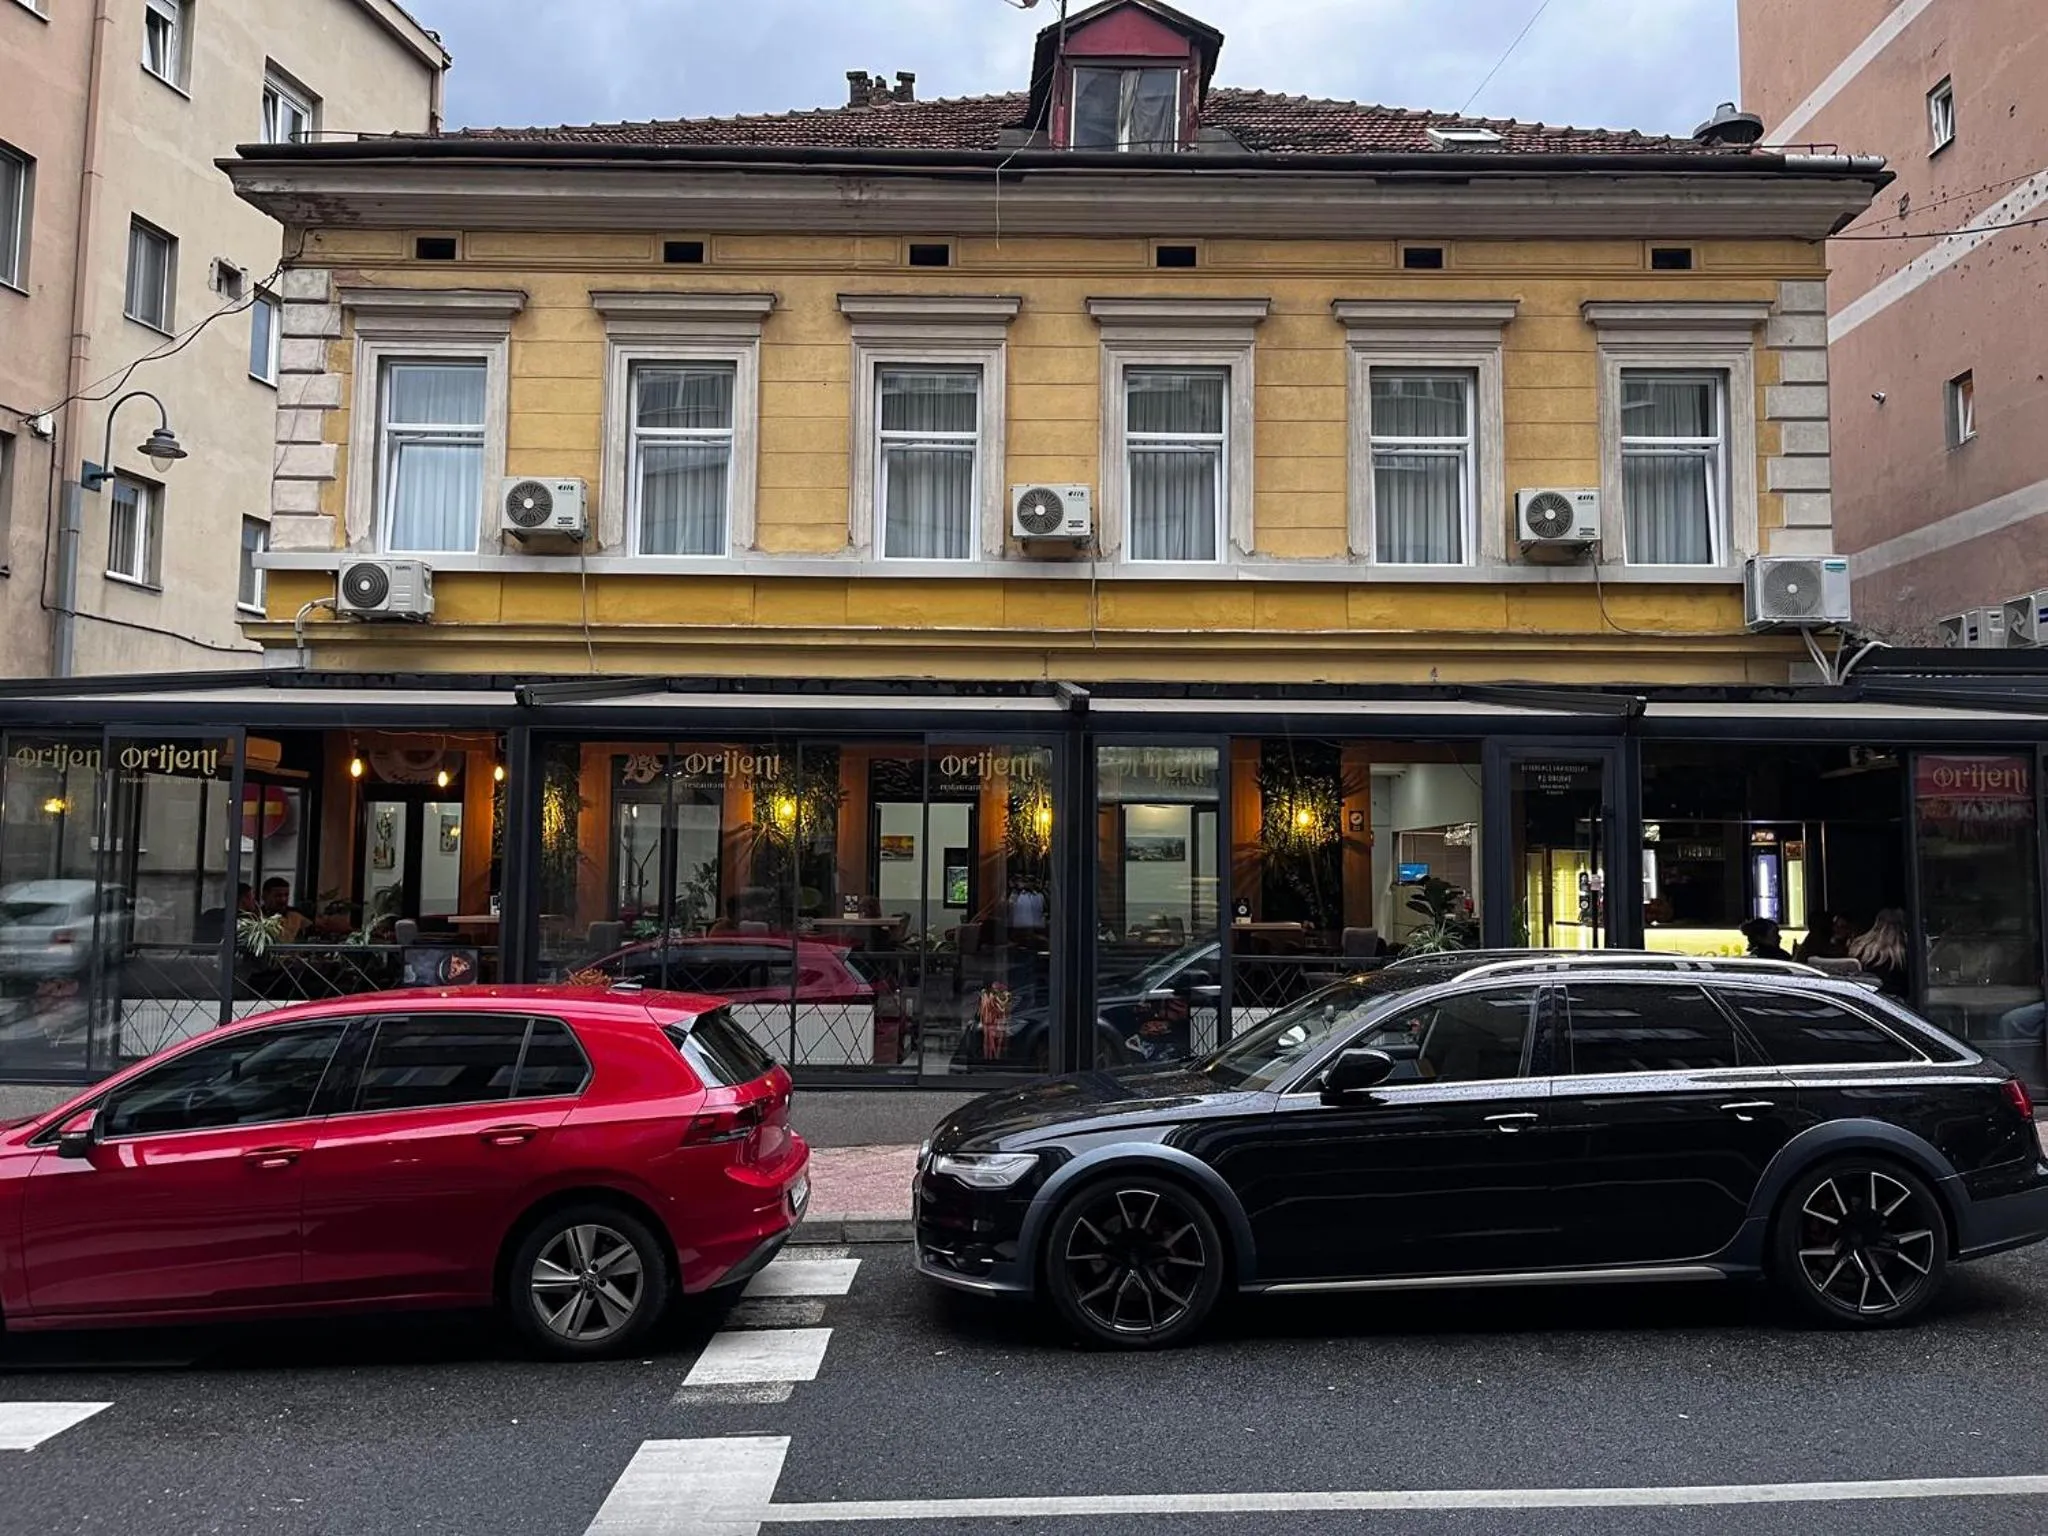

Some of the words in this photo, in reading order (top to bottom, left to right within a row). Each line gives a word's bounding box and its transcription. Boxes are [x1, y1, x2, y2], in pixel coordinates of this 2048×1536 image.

[15, 744, 101, 774] Orijen
[120, 744, 218, 775] Orijent
[685, 750, 780, 780] Orijent
